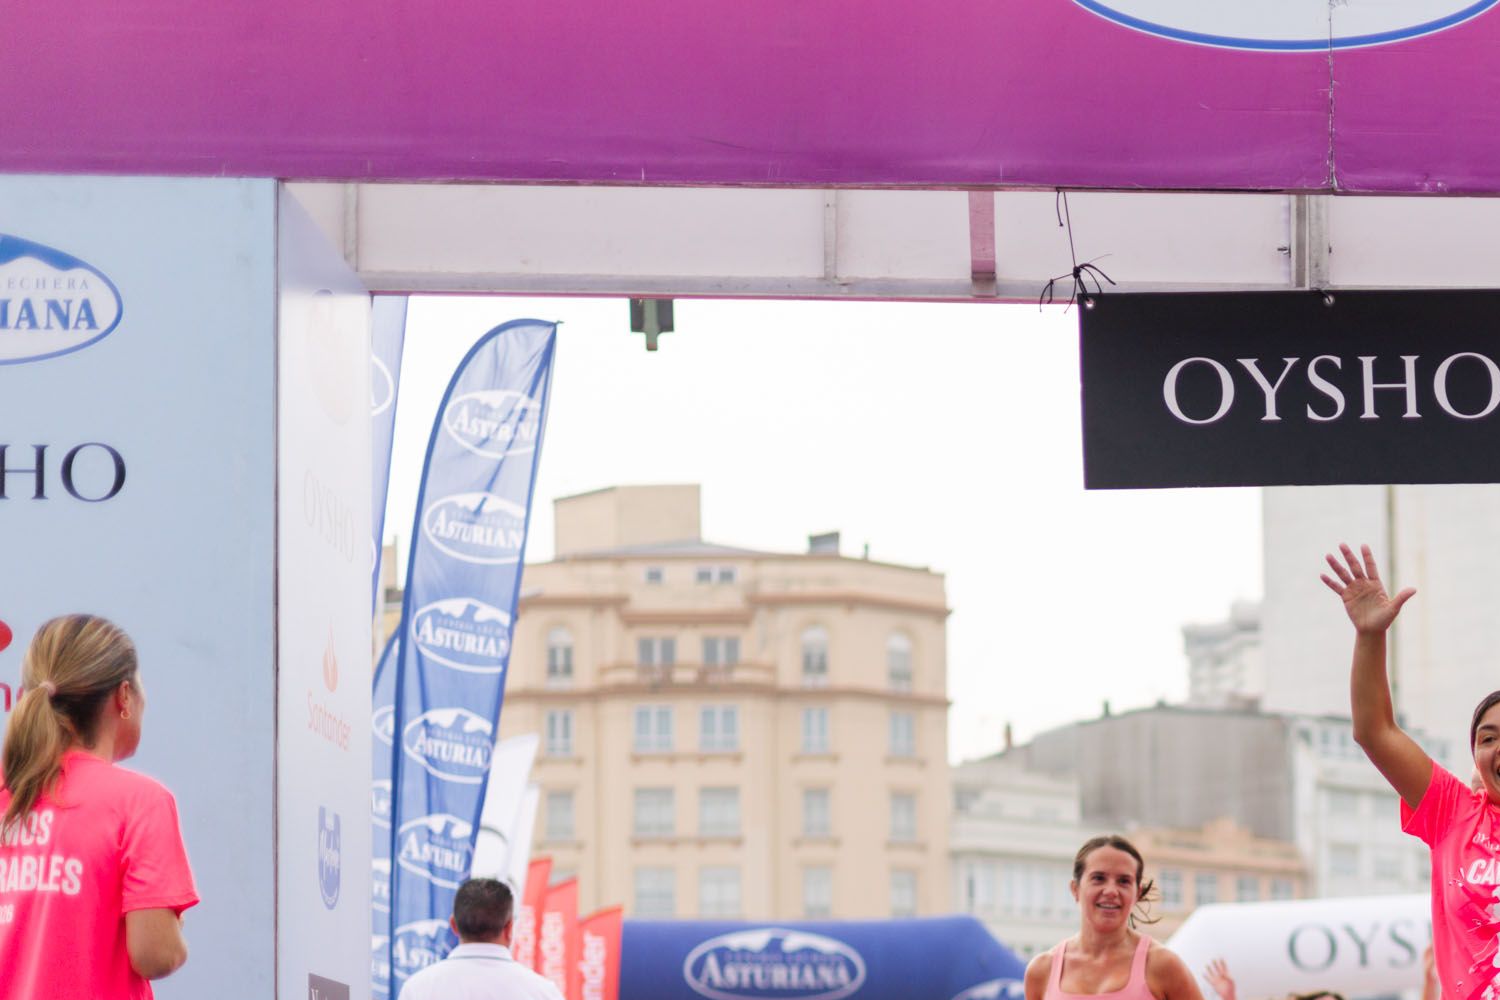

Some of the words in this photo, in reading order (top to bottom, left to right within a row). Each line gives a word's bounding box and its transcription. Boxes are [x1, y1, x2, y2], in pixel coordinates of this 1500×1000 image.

[431, 508, 524, 549] ASTURIAN
[416, 615, 508, 657] ASTURIAN
[306, 688, 351, 752] Santander
[1288, 920, 1432, 973] OYS
[700, 951, 850, 989] ASTURIANA
